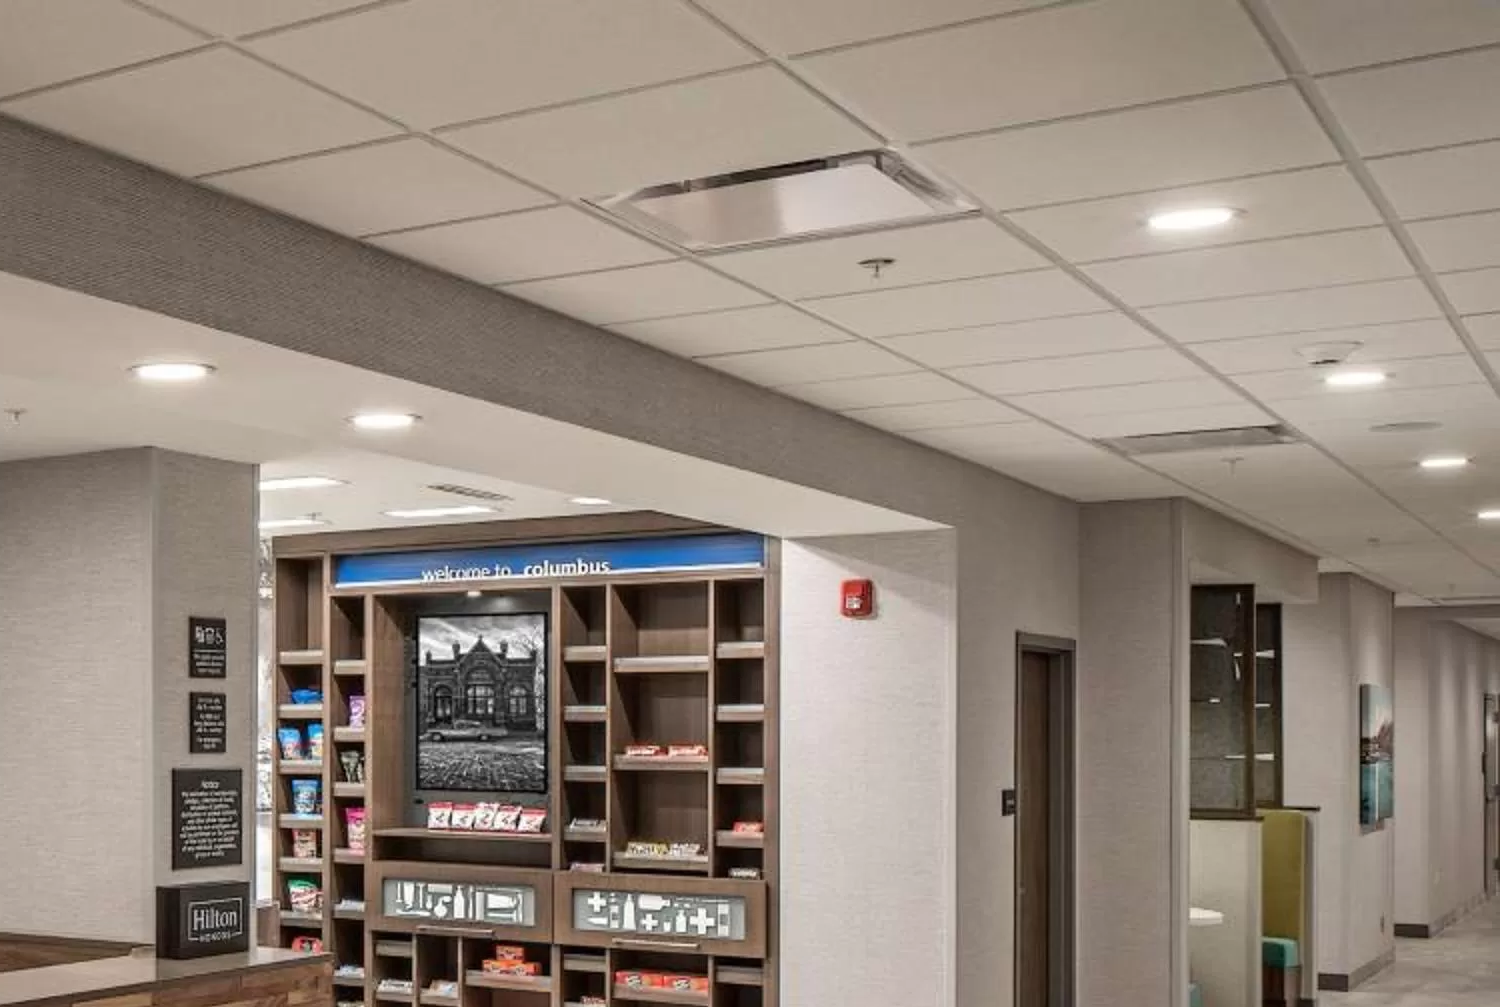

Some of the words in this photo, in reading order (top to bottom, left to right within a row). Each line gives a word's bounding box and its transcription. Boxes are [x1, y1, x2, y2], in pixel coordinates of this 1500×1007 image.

[421, 564, 491, 581] welcome
[495, 563, 511, 578] to
[523, 557, 611, 576] columbus
[192, 907, 237, 931] Hilton
